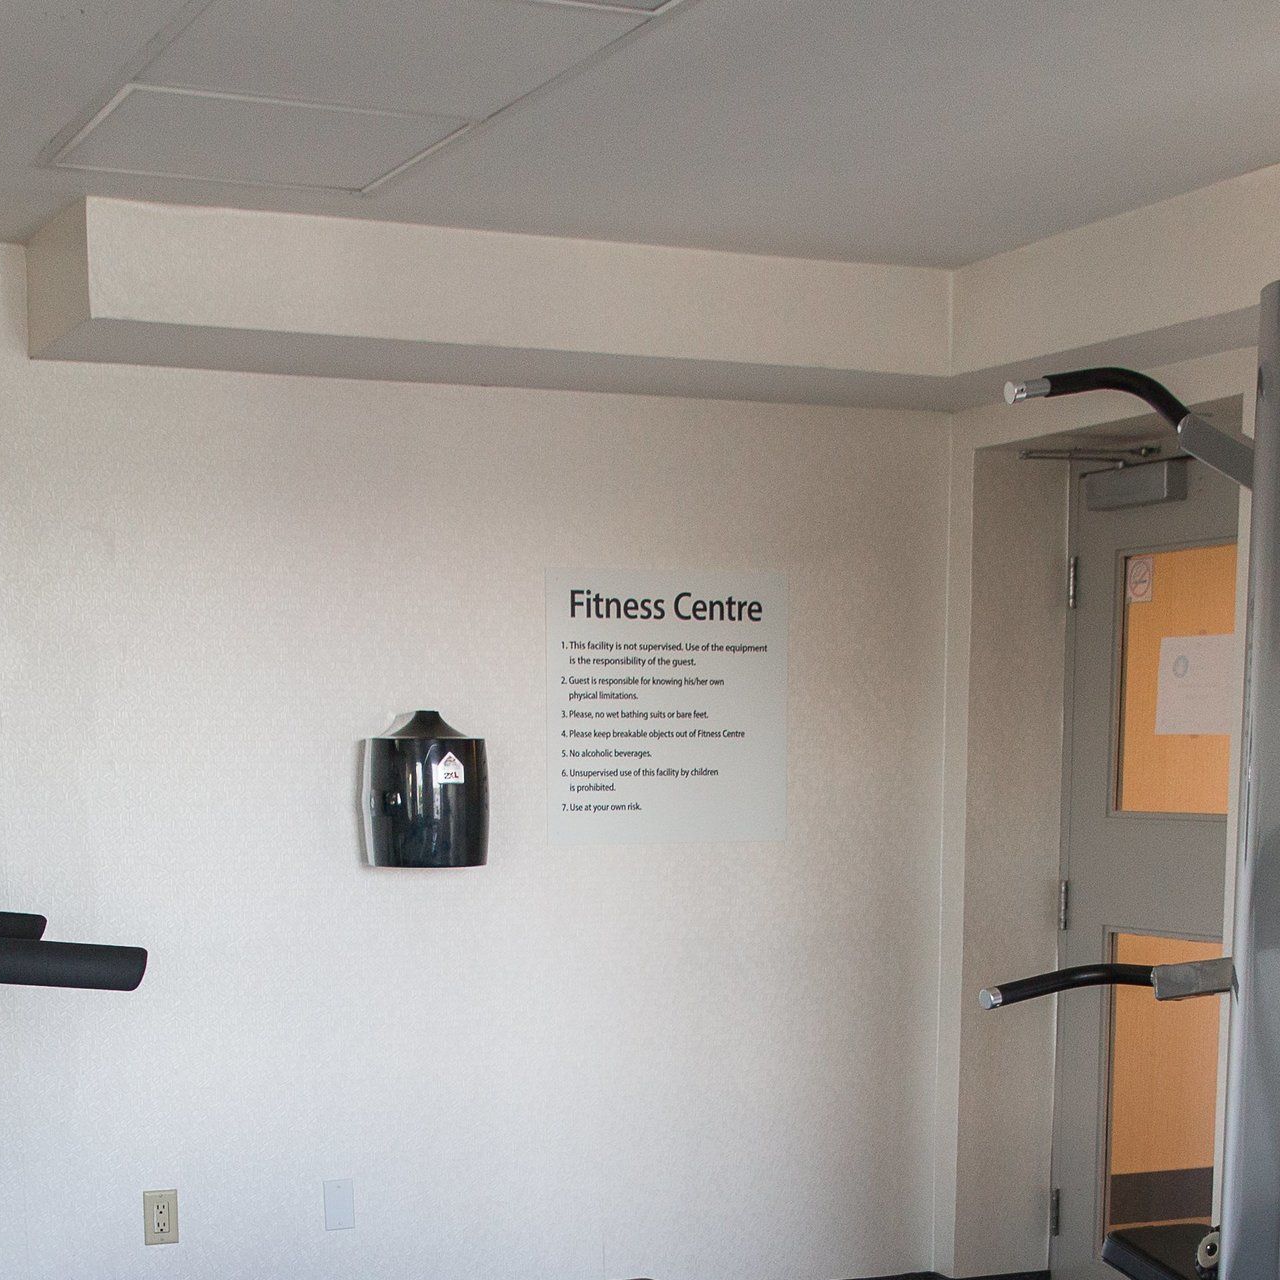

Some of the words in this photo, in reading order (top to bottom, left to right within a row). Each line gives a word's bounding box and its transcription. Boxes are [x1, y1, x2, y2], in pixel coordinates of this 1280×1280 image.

[569, 589, 666, 620] Fitness
[673, 592, 763, 622] Centre
[561, 640, 568, 651] 1.
[569, 640, 586, 651] This
[587, 640, 614, 652] facility
[615, 641, 622, 651] is
[623, 642, 637, 651] not
[638, 642, 684, 653] supervised.
[685, 642, 700, 652] Use
[701, 642, 710, 652] of
[710, 642, 724, 652] the
[725, 643, 768, 654] equipment
[569, 656, 576, 666] is
[577, 656, 591, 666] the
[592, 656, 646, 668] responsibility
[647, 656, 656, 666] of
[657, 656, 671, 666] the
[672, 657, 696, 669] guest.
[561, 677, 568, 686] 2.
[568, 677, 590, 686] Guest
[590, 677, 597, 686] is
[598, 677, 639, 688] responsible
[640, 677, 651, 686] for
[652, 677, 683, 688] knowing
[683, 677, 708, 687] his/her
[709, 679, 725, 687] own
[568, 691, 598, 703] physical
[599, 691, 639, 701] limitations.
[561, 710, 568, 719] 3.
[569, 710, 594, 720] Please,
[595, 711, 605, 719] no
[606, 711, 619, 719] wet
[620, 710, 649, 721] bathing
[650, 710, 666, 719] suits
[676, 710, 692, 719] bare
[693, 710, 709, 719] feet.
[561, 730, 568, 739] 4.
[569, 730, 592, 739] Please
[593, 730, 611, 741] keep
[612, 730, 647, 739] breakable
[648, 730, 674, 740] objects
[675, 731, 688, 739] out
[688, 730, 697, 739] of
[697, 730, 722, 739] Fitness
[722, 730, 745, 739] Centre
[561, 749, 568, 759] 5.
[569, 749, 580, 758] No
[581, 749, 613, 758] alcoholic
[614, 749, 652, 760] beverages.
[561, 769, 569, 778] 6.
[569, 768, 619, 779] Unsupervised
[633, 768, 642, 777] of
[642, 768, 655, 777] this
[656, 768, 679, 779] facility
[680, 768, 690, 778] by
[690, 768, 719, 777] children
[569, 784, 576, 792] is
[576, 783, 616, 794] prohibited.
[562, 803, 569, 813] 7.
[569, 803, 583, 812] Use
[584, 804, 592, 812] at
[592, 804, 609, 813] your
[610, 804, 626, 812] own
[627, 803, 642, 811] risk.
